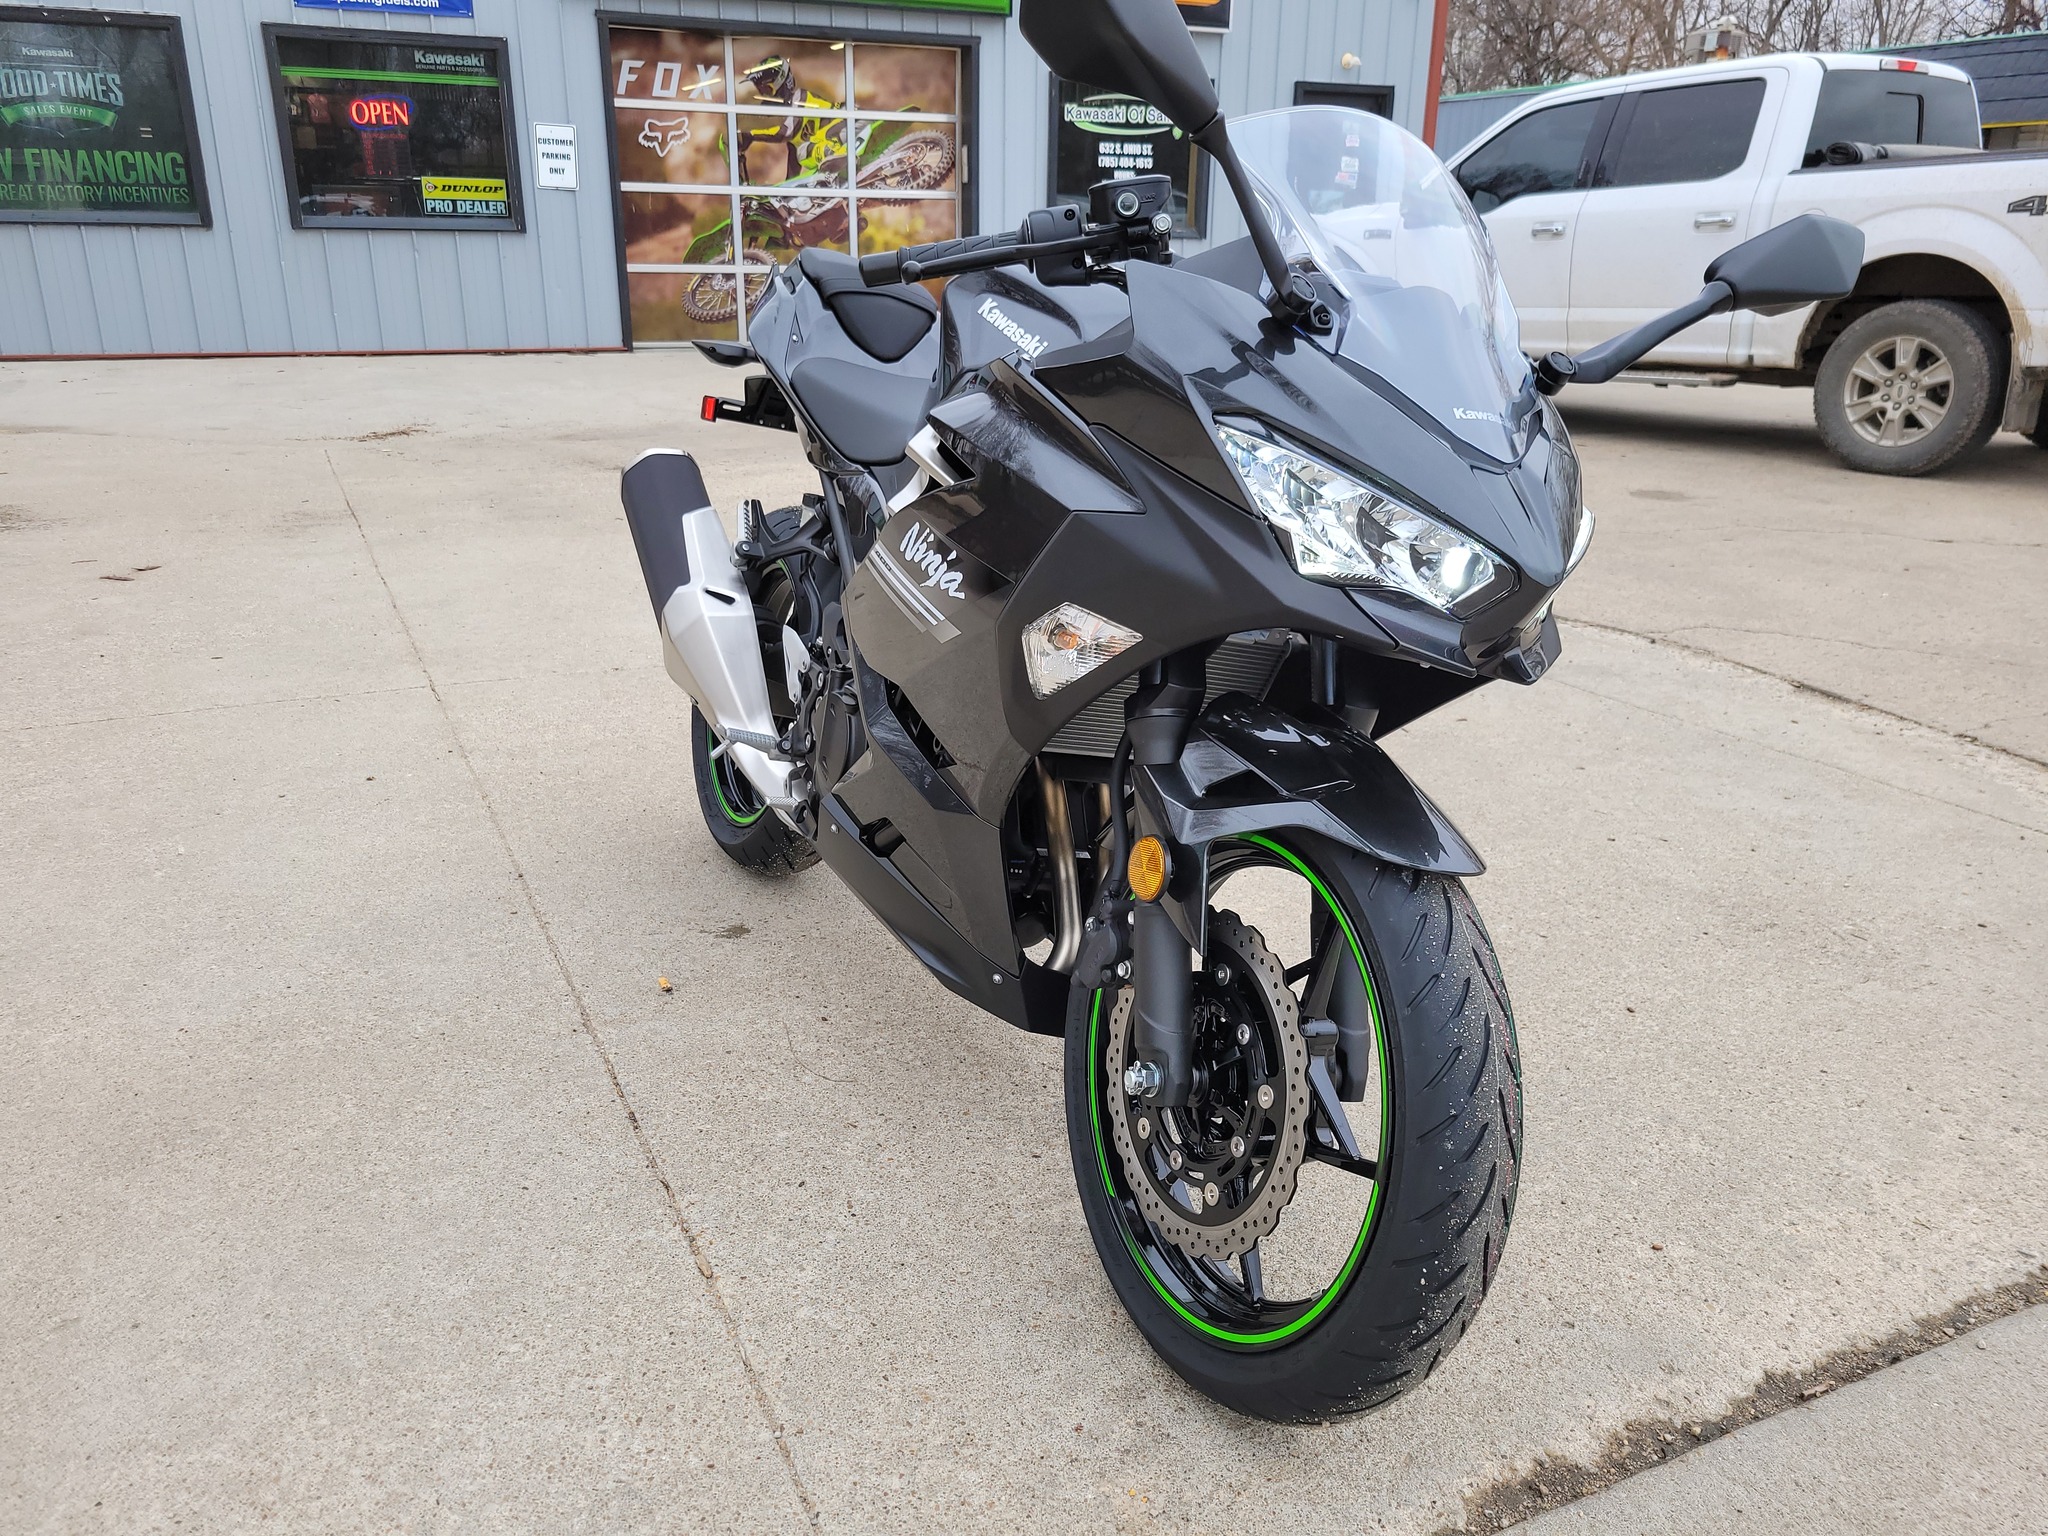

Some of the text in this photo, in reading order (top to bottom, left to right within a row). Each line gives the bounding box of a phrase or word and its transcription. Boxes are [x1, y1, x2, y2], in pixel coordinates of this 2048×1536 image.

[22, 46, 74, 58] Kawasaki
[414, 50, 485, 67] Kawasaki
[0, 69, 124, 107] OOD TIMES
[616, 59, 720, 101] FOX
[23, 105, 93, 117] SALES EVENT
[350, 100, 410, 126] OPEN
[1065, 105, 1125, 122] Kawasaki
[1128, 107, 1145, 122] Of
[537, 137, 574, 147] CUSTOMER
[1099, 142, 1115, 154] 632
[1123, 143, 1141, 155] OHIO
[1142, 144, 1153, 156] ST.
[541, 151, 571, 160] PARKING
[1119, 157, 1153, 169] 404-1613
[24, 148, 188, 185] FINANCING
[549, 166, 565, 175] ONLY
[38, 185, 104, 202] FACTORY
[108, 186, 190, 204] INCENTIVES
[440, 184, 503, 194] DUNLOP
[426, 199, 506, 214] PRO DEALER
[977, 297, 1049, 359] Kawasaki
[900, 521, 966, 600] Ninja
